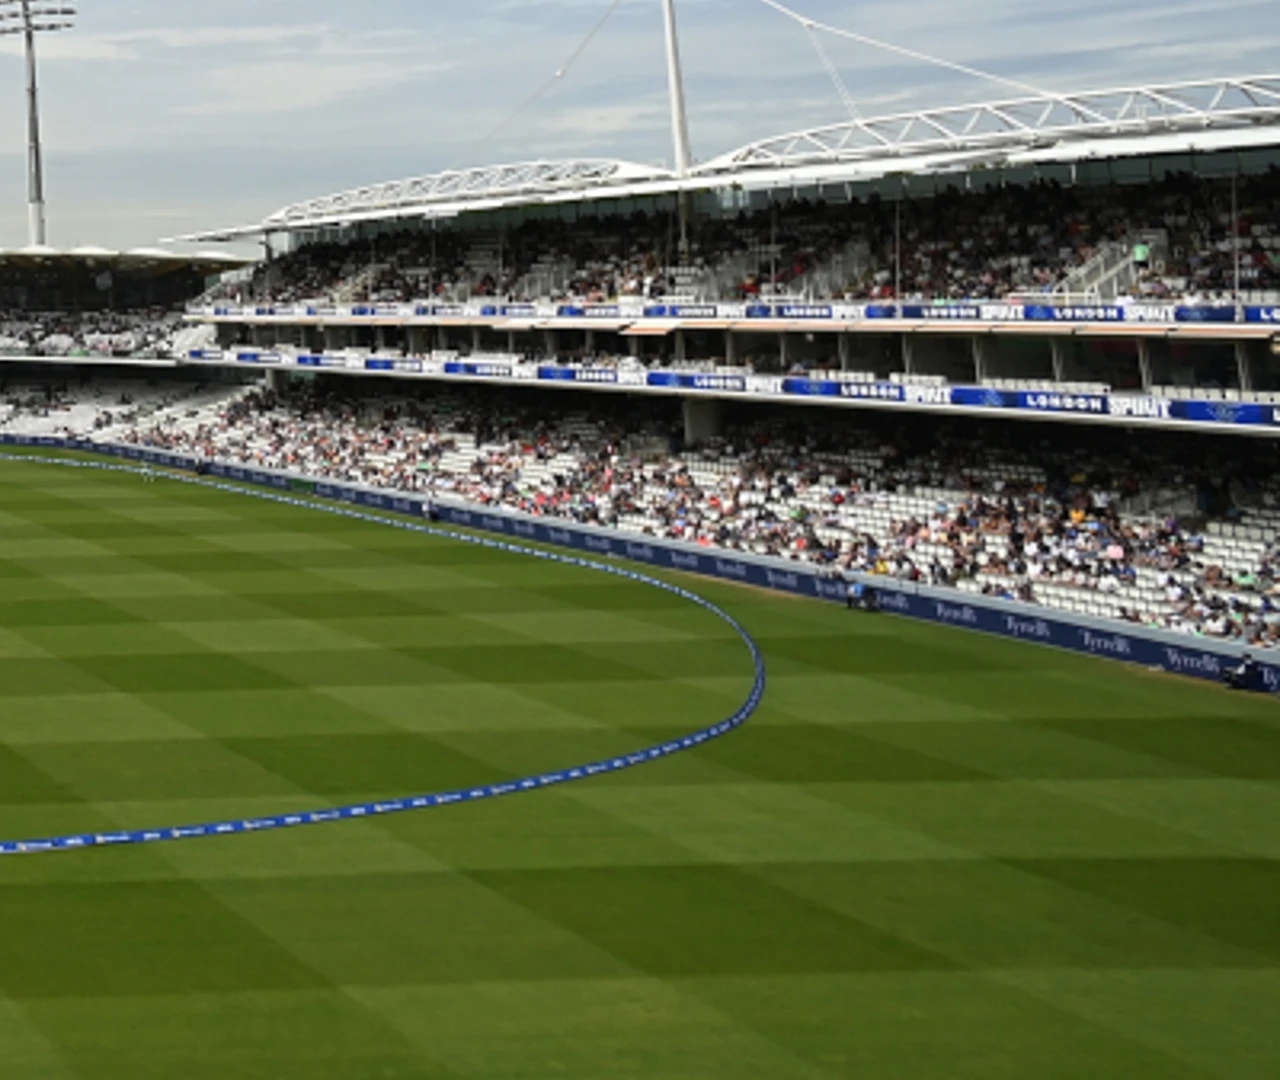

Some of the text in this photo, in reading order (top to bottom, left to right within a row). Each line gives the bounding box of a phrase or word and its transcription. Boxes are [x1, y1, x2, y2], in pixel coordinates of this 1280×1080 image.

[1053, 307, 1118, 319] LONDON
[1026, 393, 1172, 418] LONDON SPIRIT
[1003, 614, 1051, 637] Tyrrells
[1077, 628, 1132, 655] Tyrrells
[1163, 646, 1221, 674] Tyrrells
